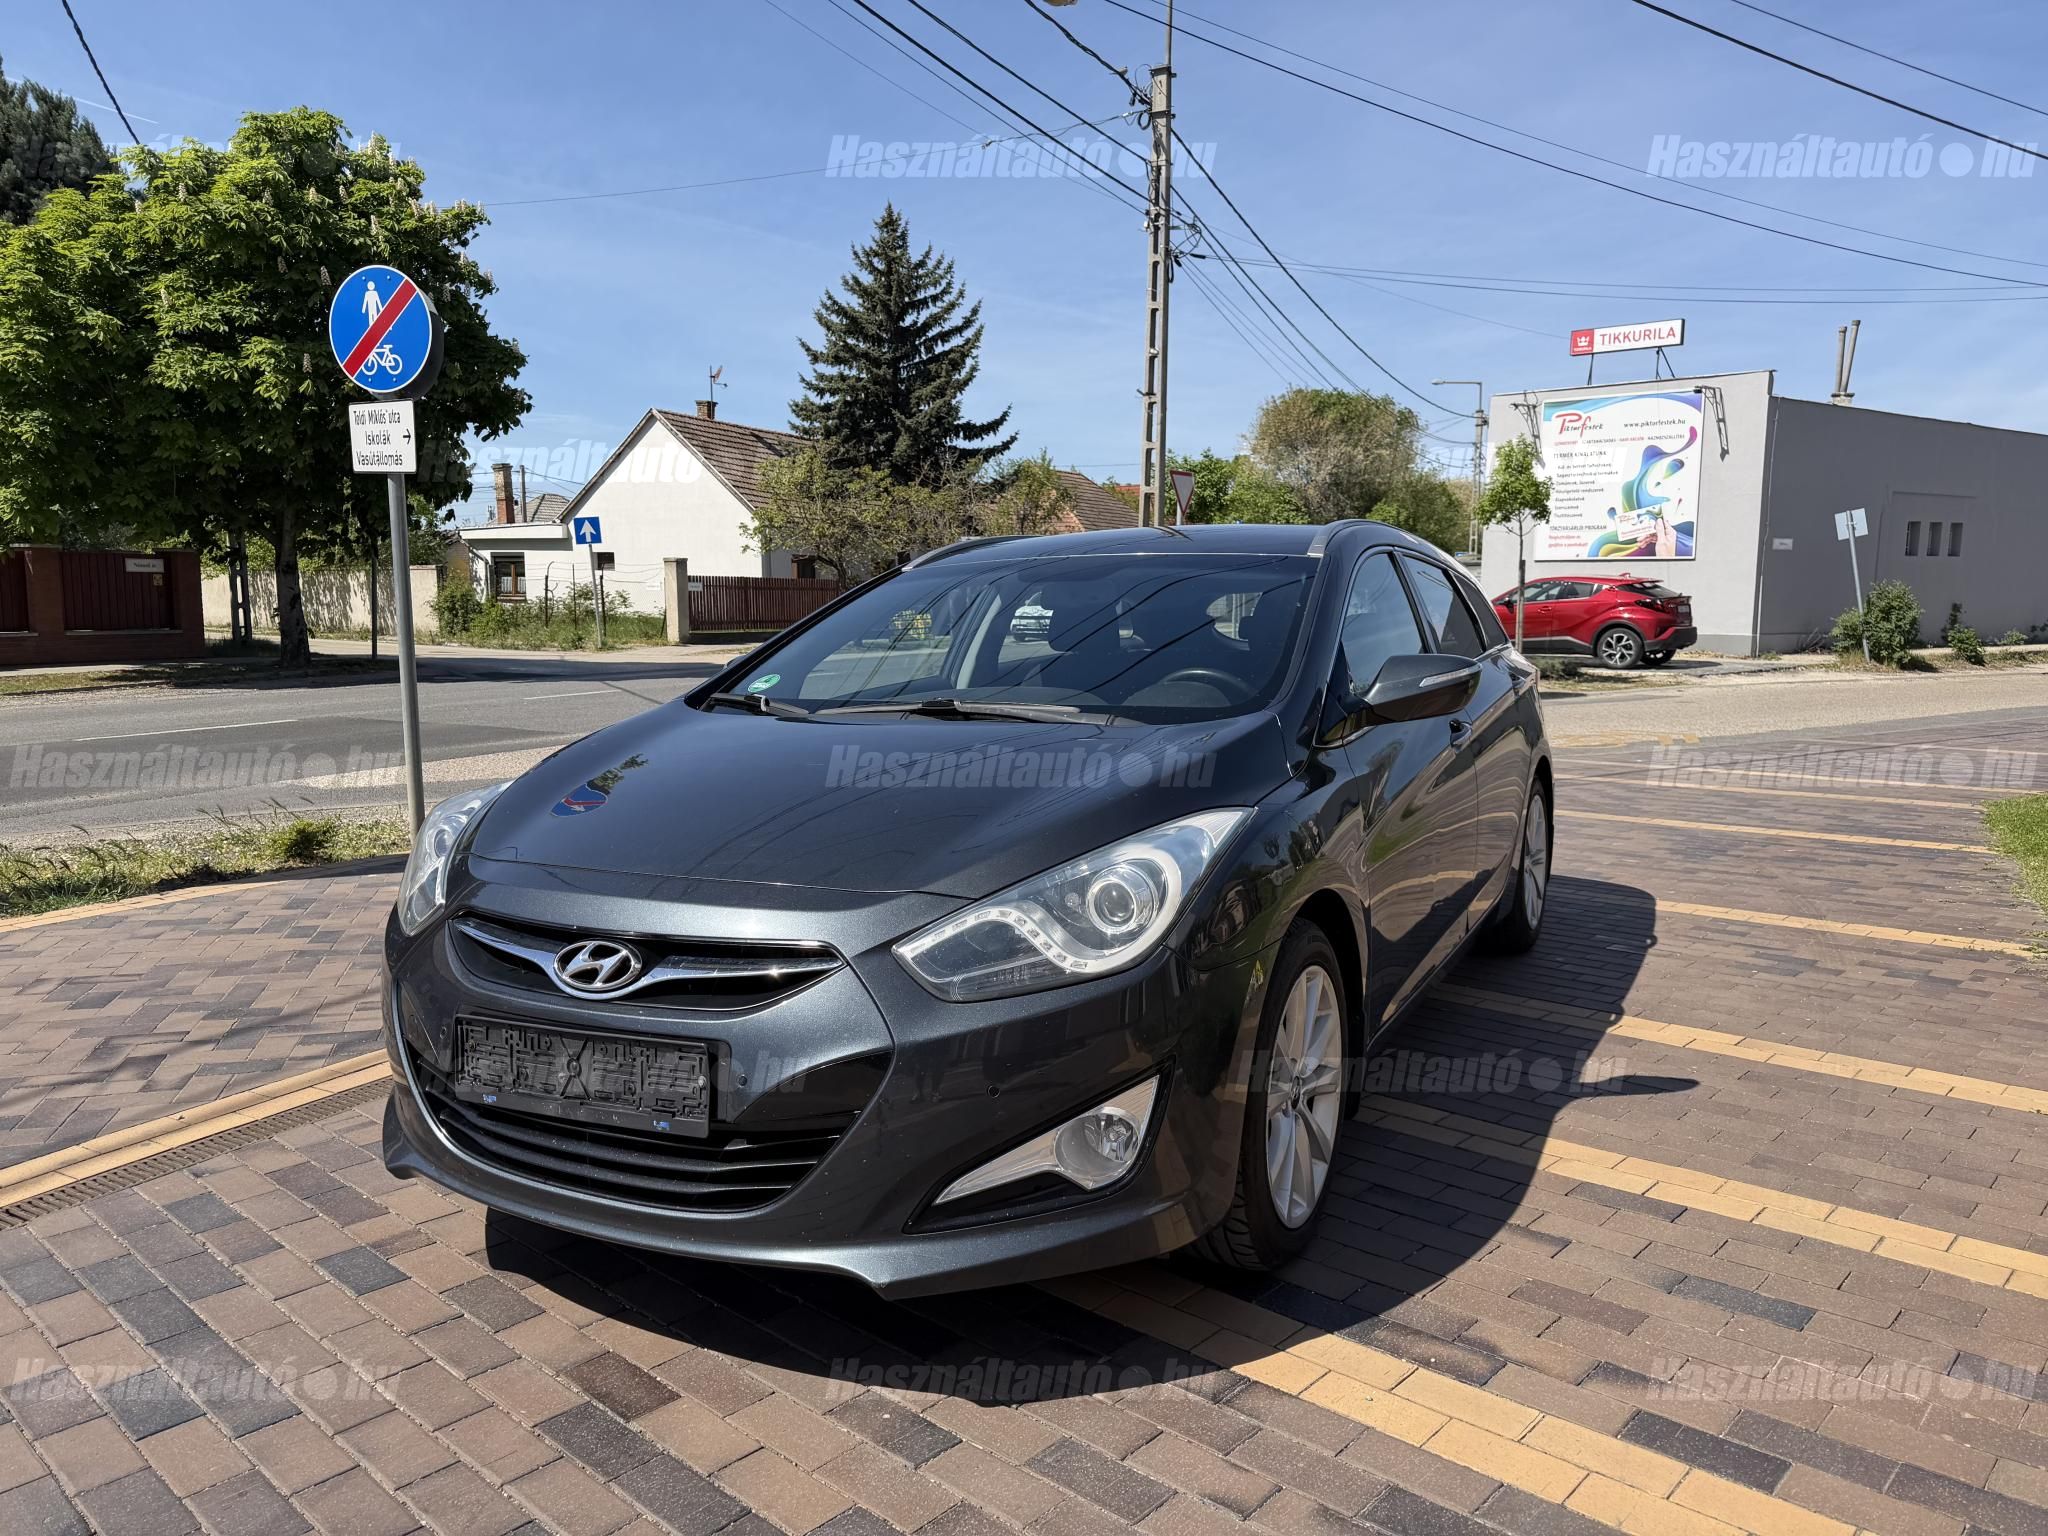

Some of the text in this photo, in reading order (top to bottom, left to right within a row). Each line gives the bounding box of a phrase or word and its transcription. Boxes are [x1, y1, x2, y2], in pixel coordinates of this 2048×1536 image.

[1600, 327, 1676, 346] TIKKURILA
[388, 408, 401, 424] utca
[365, 429, 391, 445] Iskolák
[356, 450, 403, 466] Vasútállomás
